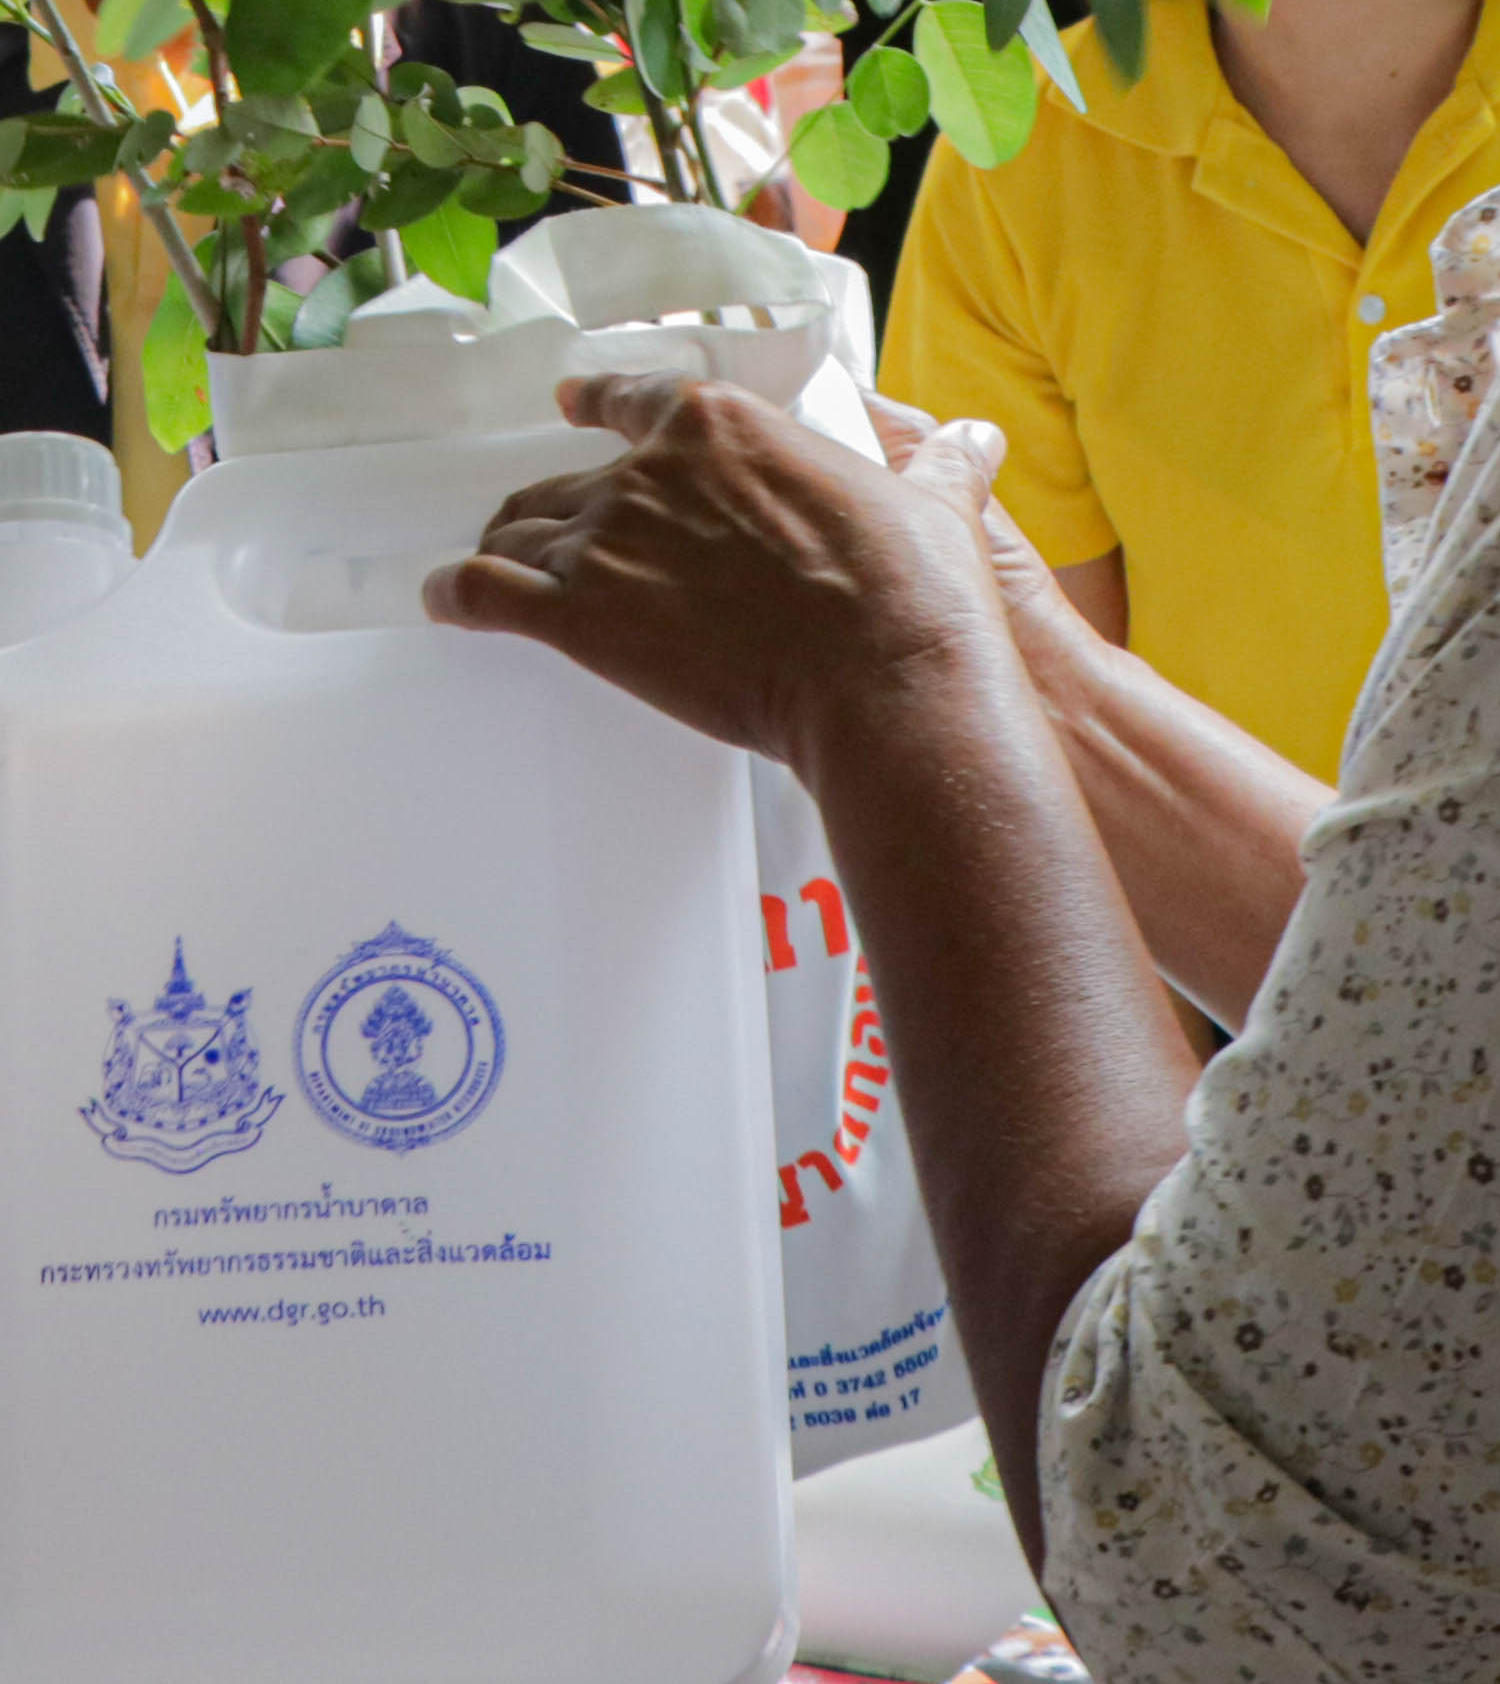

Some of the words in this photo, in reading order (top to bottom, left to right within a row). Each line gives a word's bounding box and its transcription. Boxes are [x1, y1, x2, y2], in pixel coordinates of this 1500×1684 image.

[152, 1182, 429, 1228] กรมทรัพยากรน้ำบาดาล
[39, 1231, 552, 1285] กระทรวงทรัพยากรธรรมชาติและสิ่งแวดล้อม
[198, 1295, 386, 1326] www.dgr.go.th
